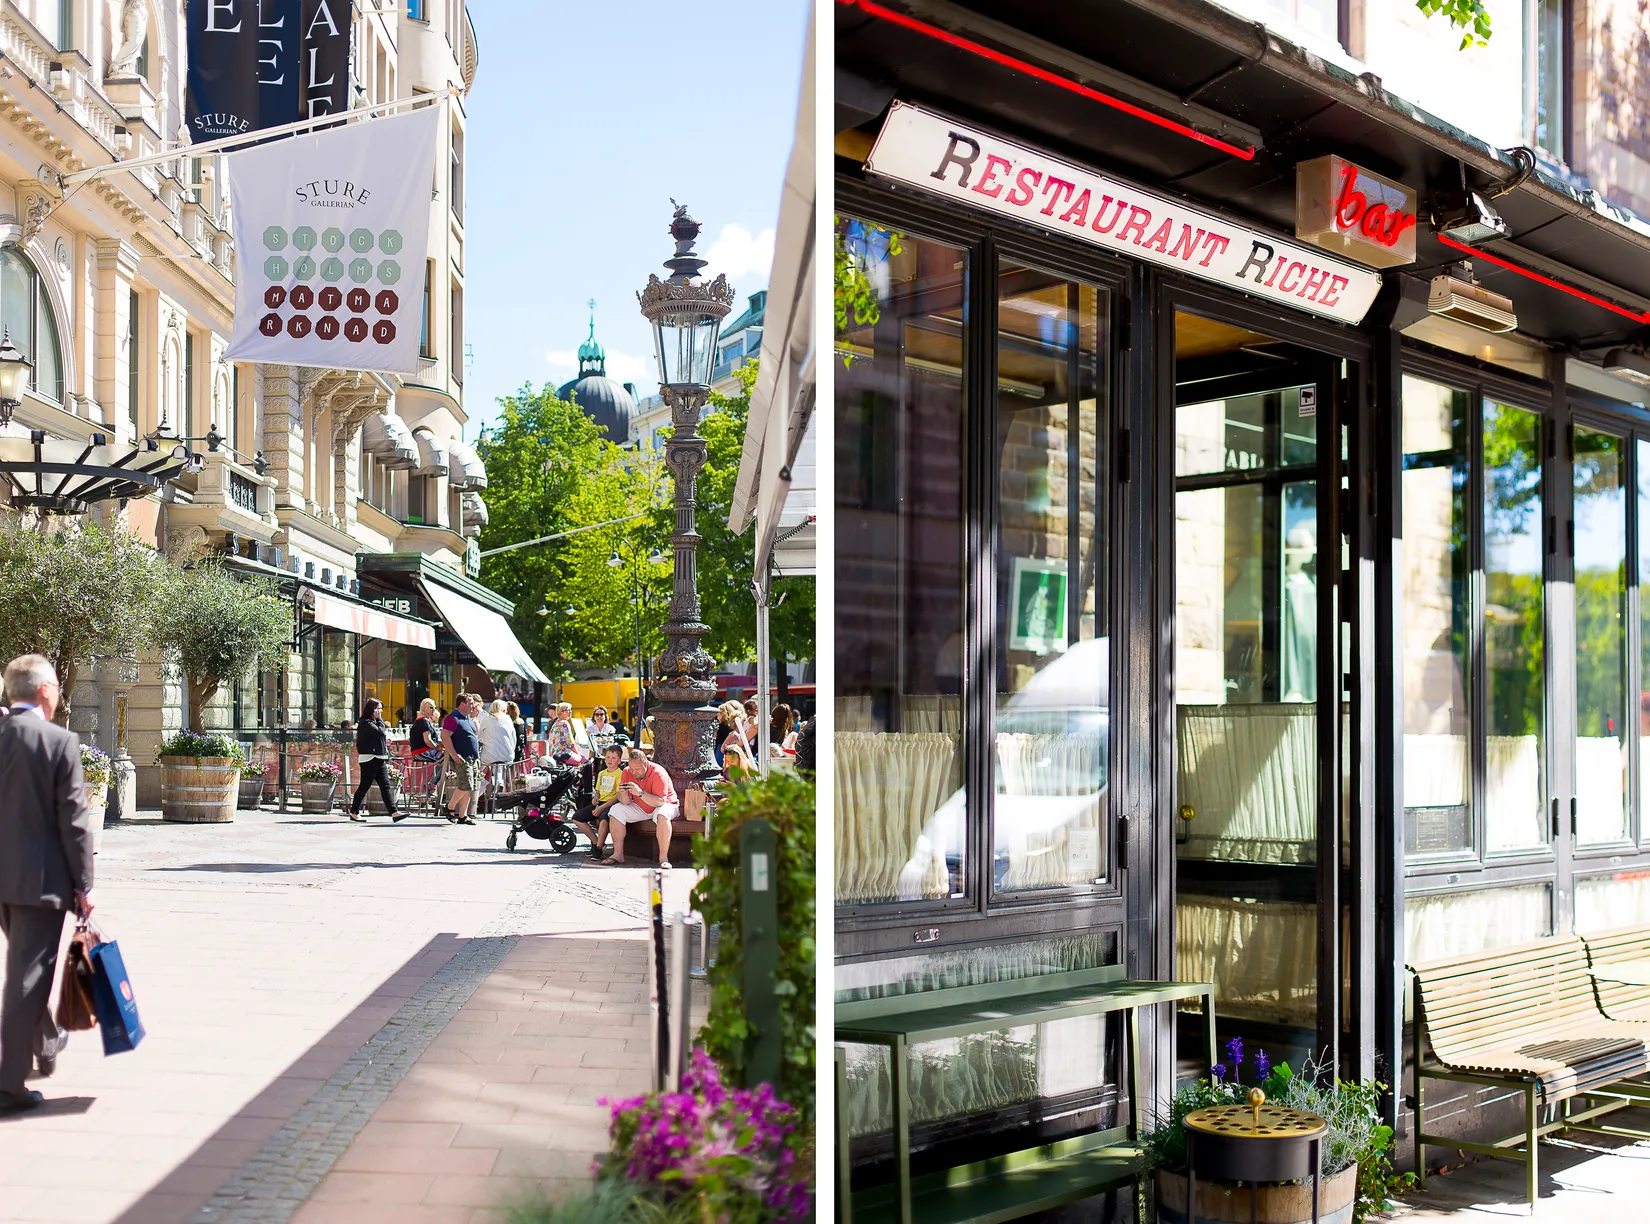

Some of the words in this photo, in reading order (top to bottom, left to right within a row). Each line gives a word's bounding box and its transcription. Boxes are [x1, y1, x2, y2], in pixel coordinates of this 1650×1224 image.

[194, 113, 250, 132] STURE
[295, 179, 371, 205] STURE
[310, 200, 355, 209] GALLERIAN
[1336, 164, 1416, 247] bar
[372, 599, 411, 614] EB
